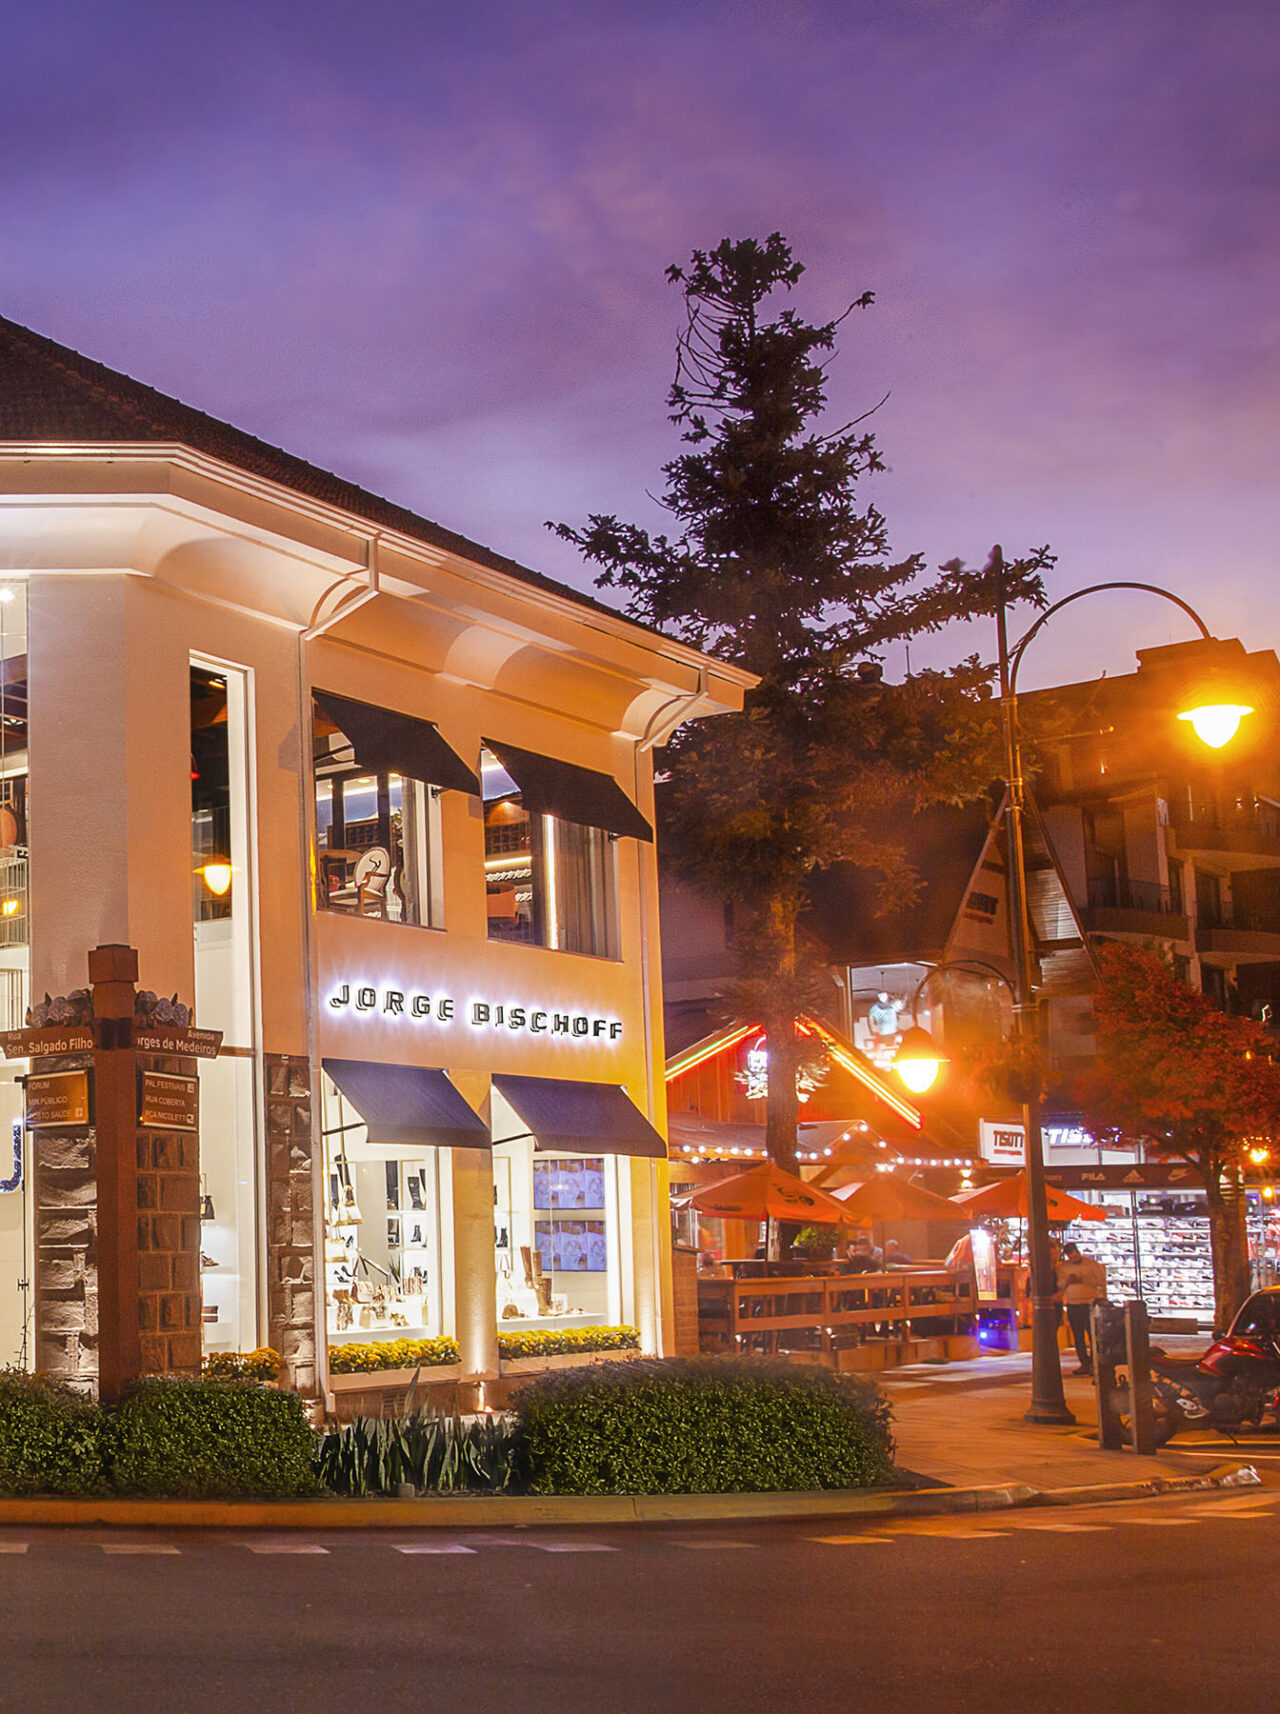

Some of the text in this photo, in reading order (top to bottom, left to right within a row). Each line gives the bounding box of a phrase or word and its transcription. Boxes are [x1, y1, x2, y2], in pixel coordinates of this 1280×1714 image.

[329, 984, 623, 1040] JORGE BISCHOFF
[7, 1032, 22, 1040] Rua
[187, 1029, 215, 1040] Avenida
[28, 1040, 68, 1055] Salgado
[69, 1037, 94, 1050] Filho
[162, 1037, 174, 1050] de
[175, 1039, 217, 1056] Medeiros
[145, 1094, 186, 1107] RUA COBERTA
[1081, 1172, 1106, 1181] FILA
